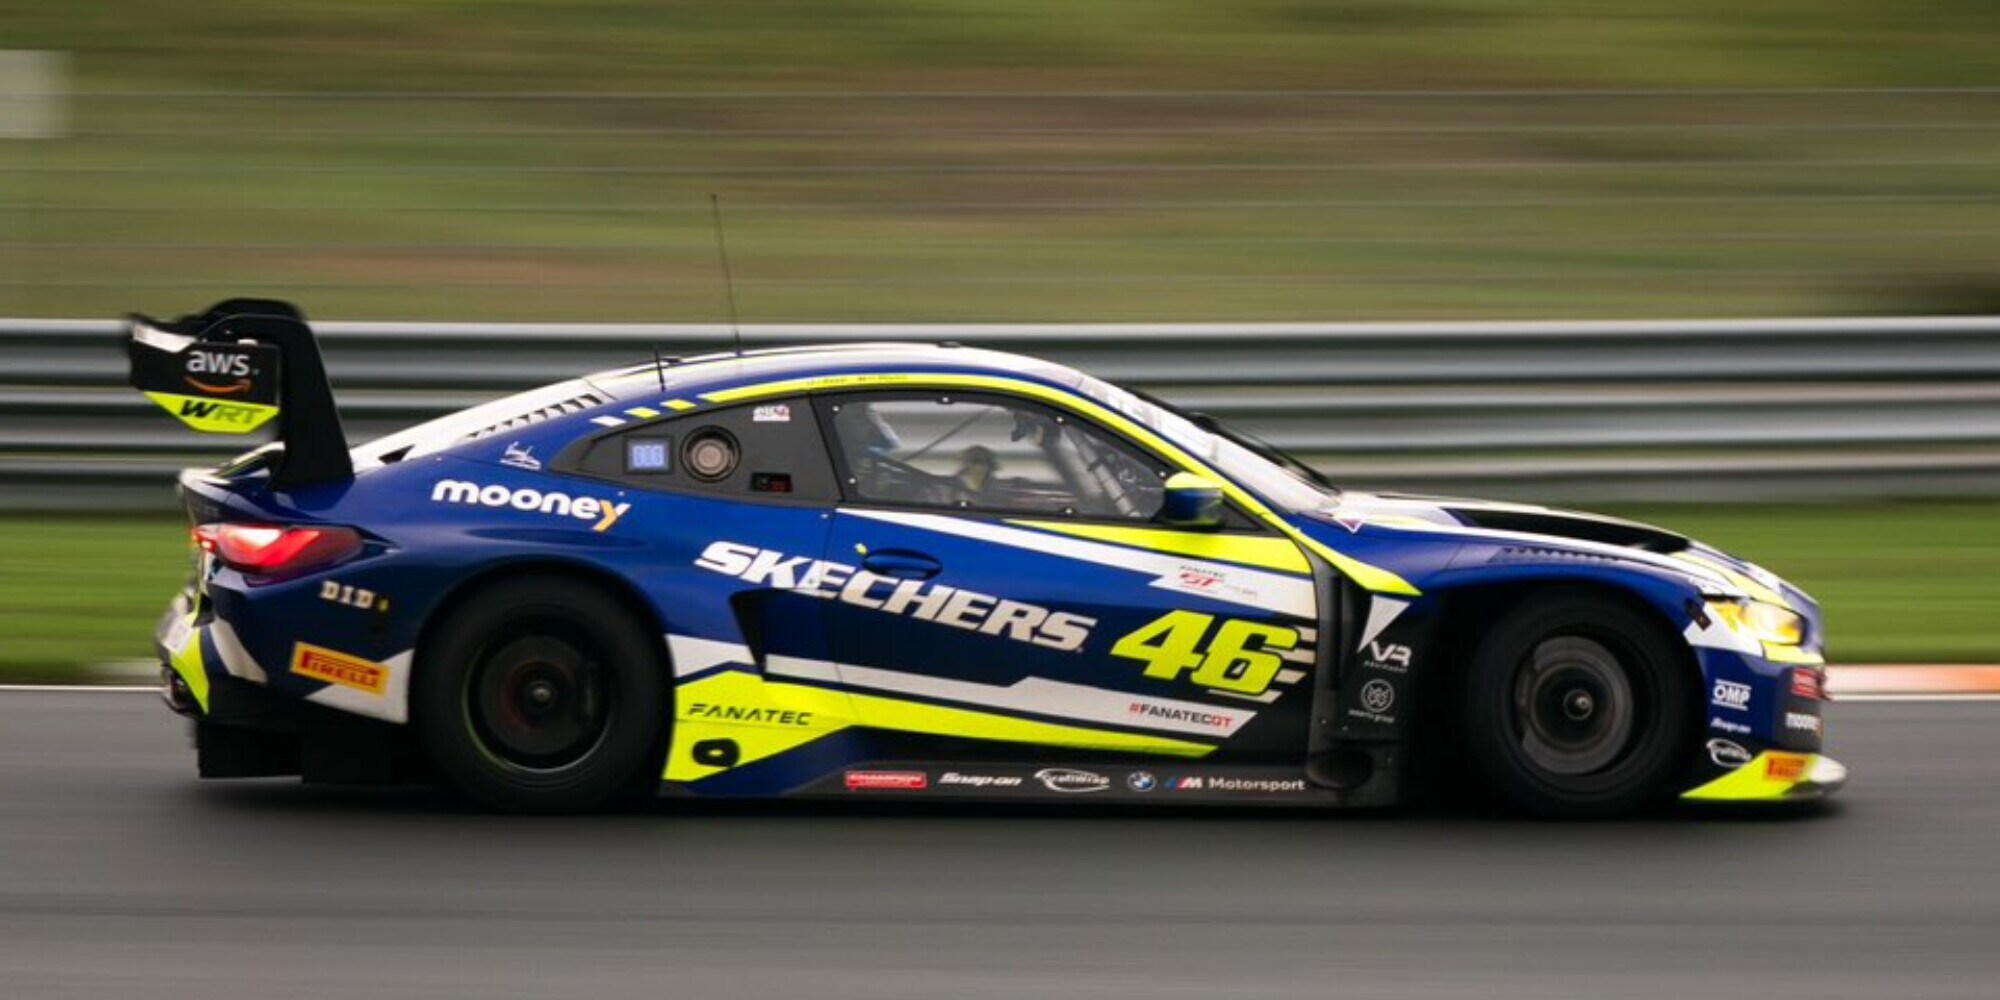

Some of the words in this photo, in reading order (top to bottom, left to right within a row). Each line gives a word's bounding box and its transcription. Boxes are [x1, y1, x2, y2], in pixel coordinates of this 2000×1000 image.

[186, 350, 250, 376] aws
[179, 399, 263, 424] WRT
[431, 478, 632, 532] mooney
[694, 540, 1097, 652] SKECHERS
[1109, 609, 1299, 697] 46
[299, 650, 382, 689] PIRELLI
[1713, 684, 1751, 706] OMP
[688, 702, 813, 726] FANATEC
[1130, 702, 1234, 728] #FANATECGT
[1208, 777, 1306, 792] Motorsport
